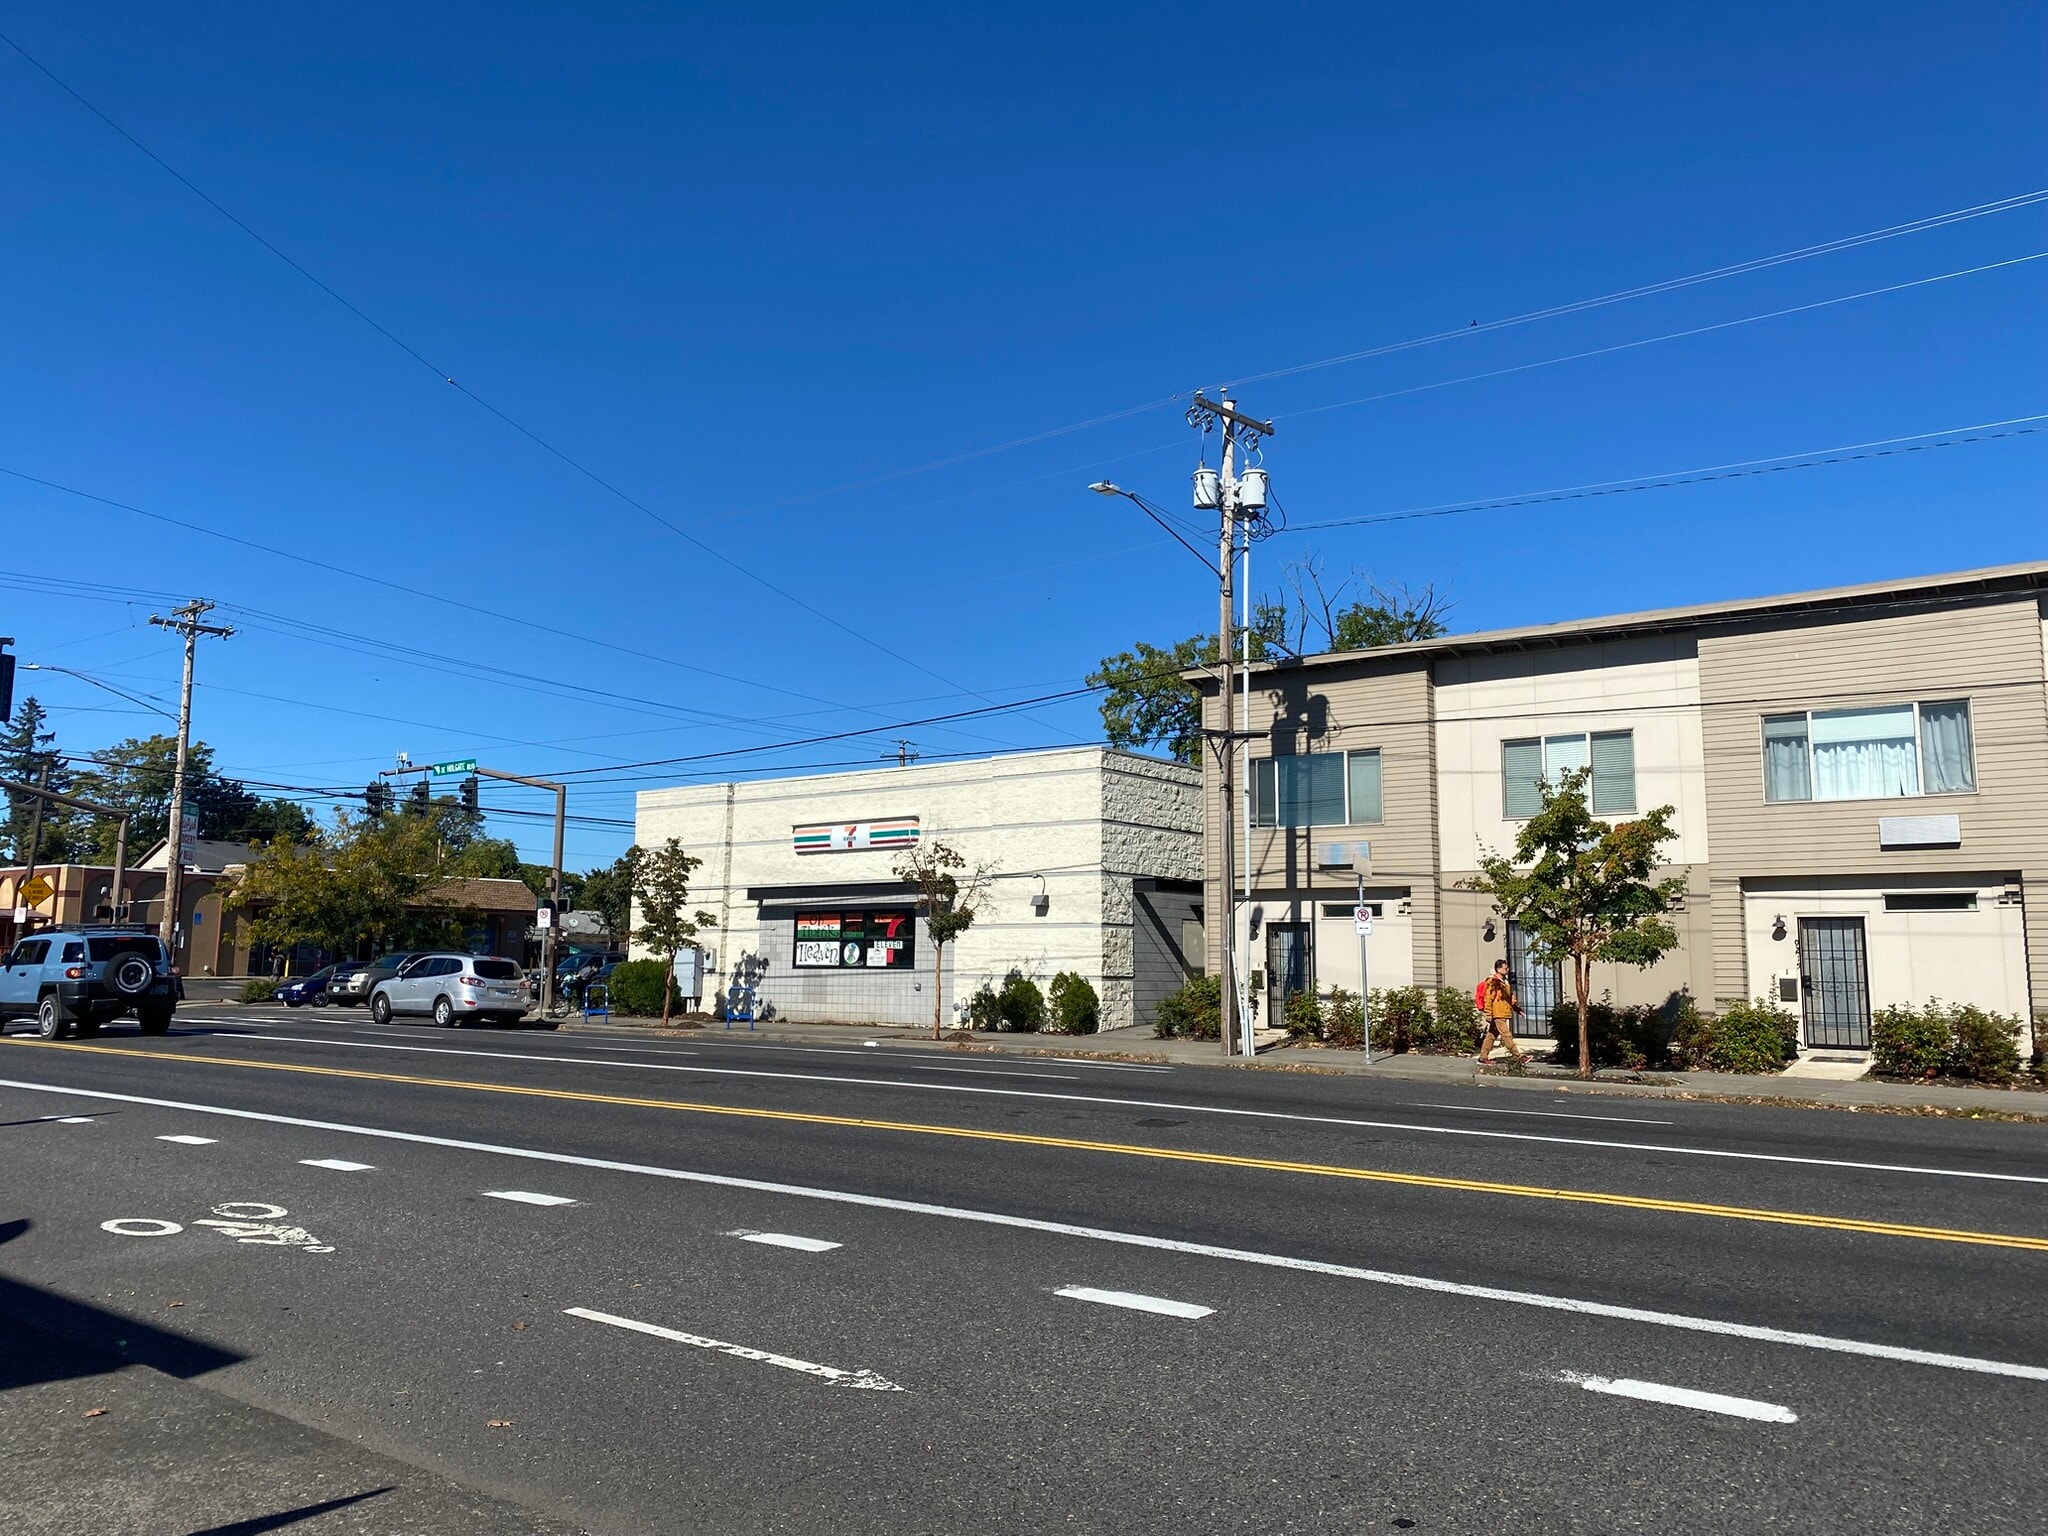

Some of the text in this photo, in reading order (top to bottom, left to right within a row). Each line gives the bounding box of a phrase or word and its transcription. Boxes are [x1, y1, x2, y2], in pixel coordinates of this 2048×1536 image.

[844, 825, 857, 848] 7
[801, 924, 839, 938] Thank
[875, 915, 905, 964] 7
